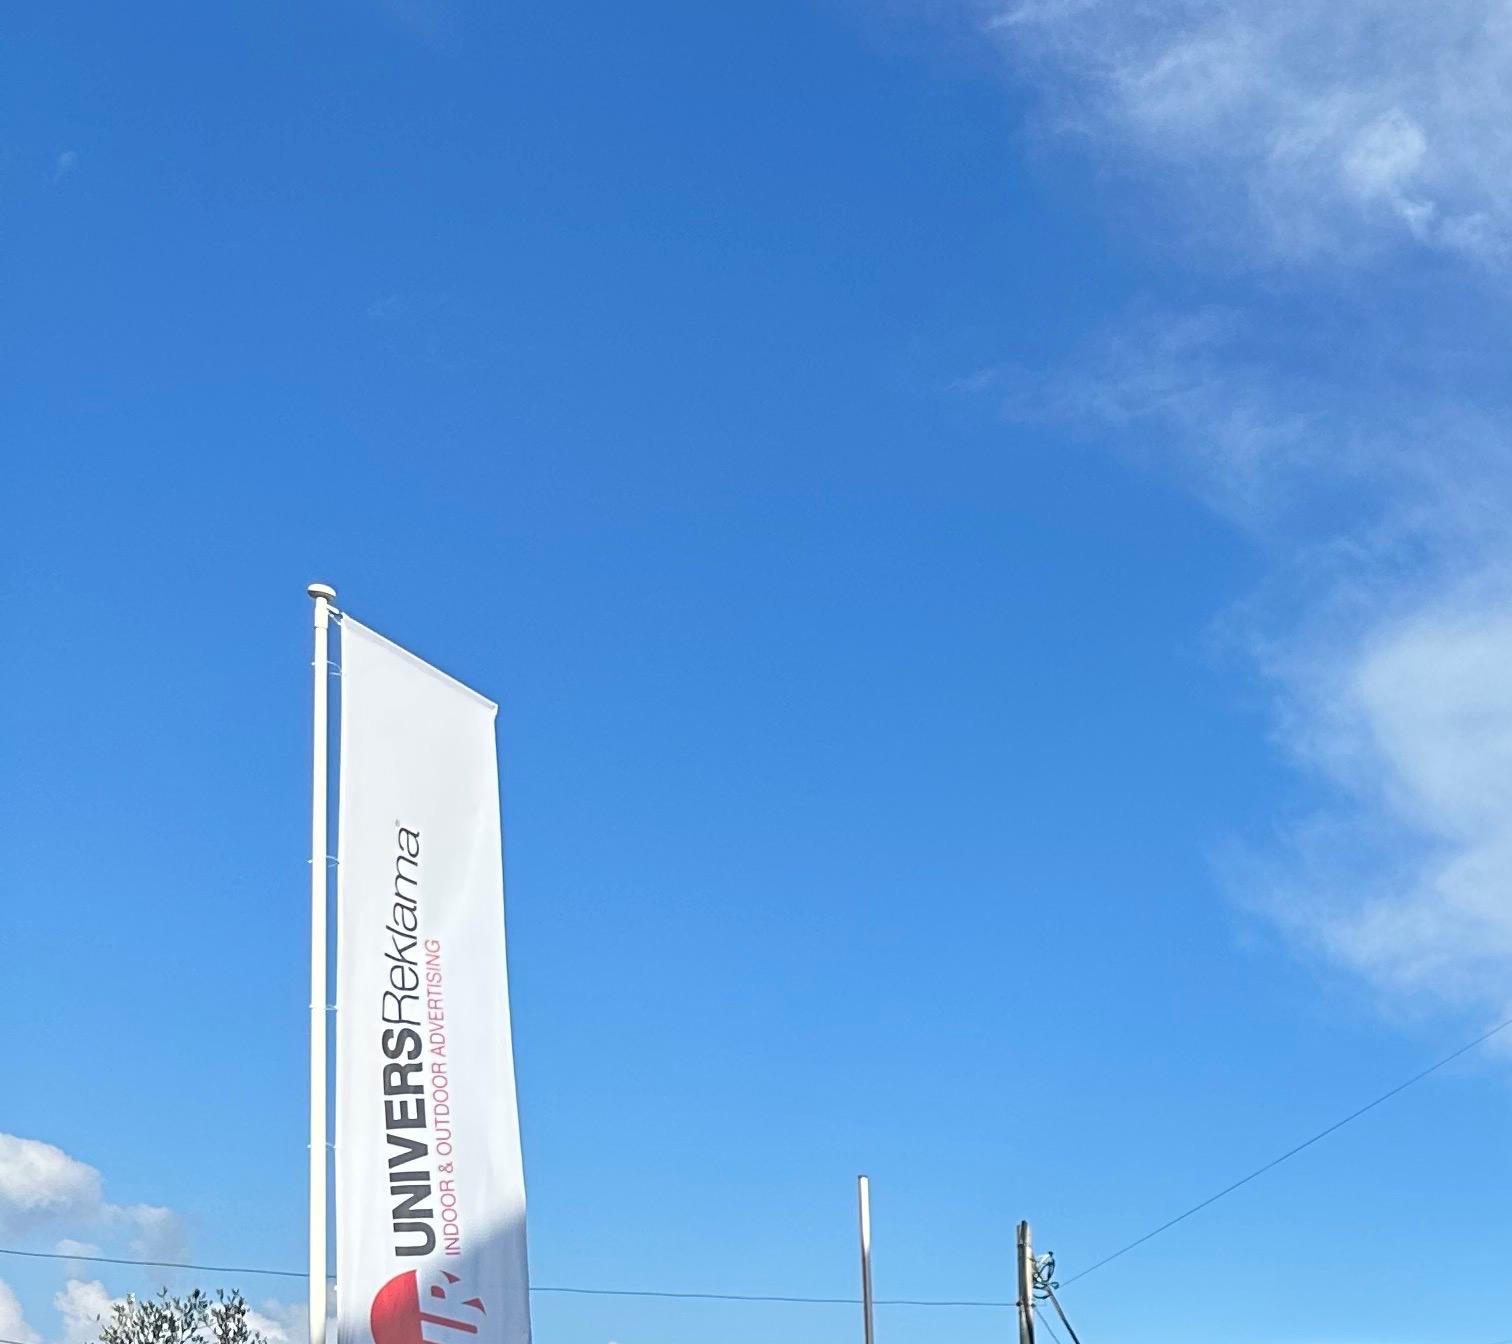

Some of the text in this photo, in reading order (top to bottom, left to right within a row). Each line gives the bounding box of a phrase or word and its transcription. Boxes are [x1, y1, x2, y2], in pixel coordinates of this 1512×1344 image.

[424, 939, 461, 1256] INDOOR & OUTDOOR ADVERTISING
